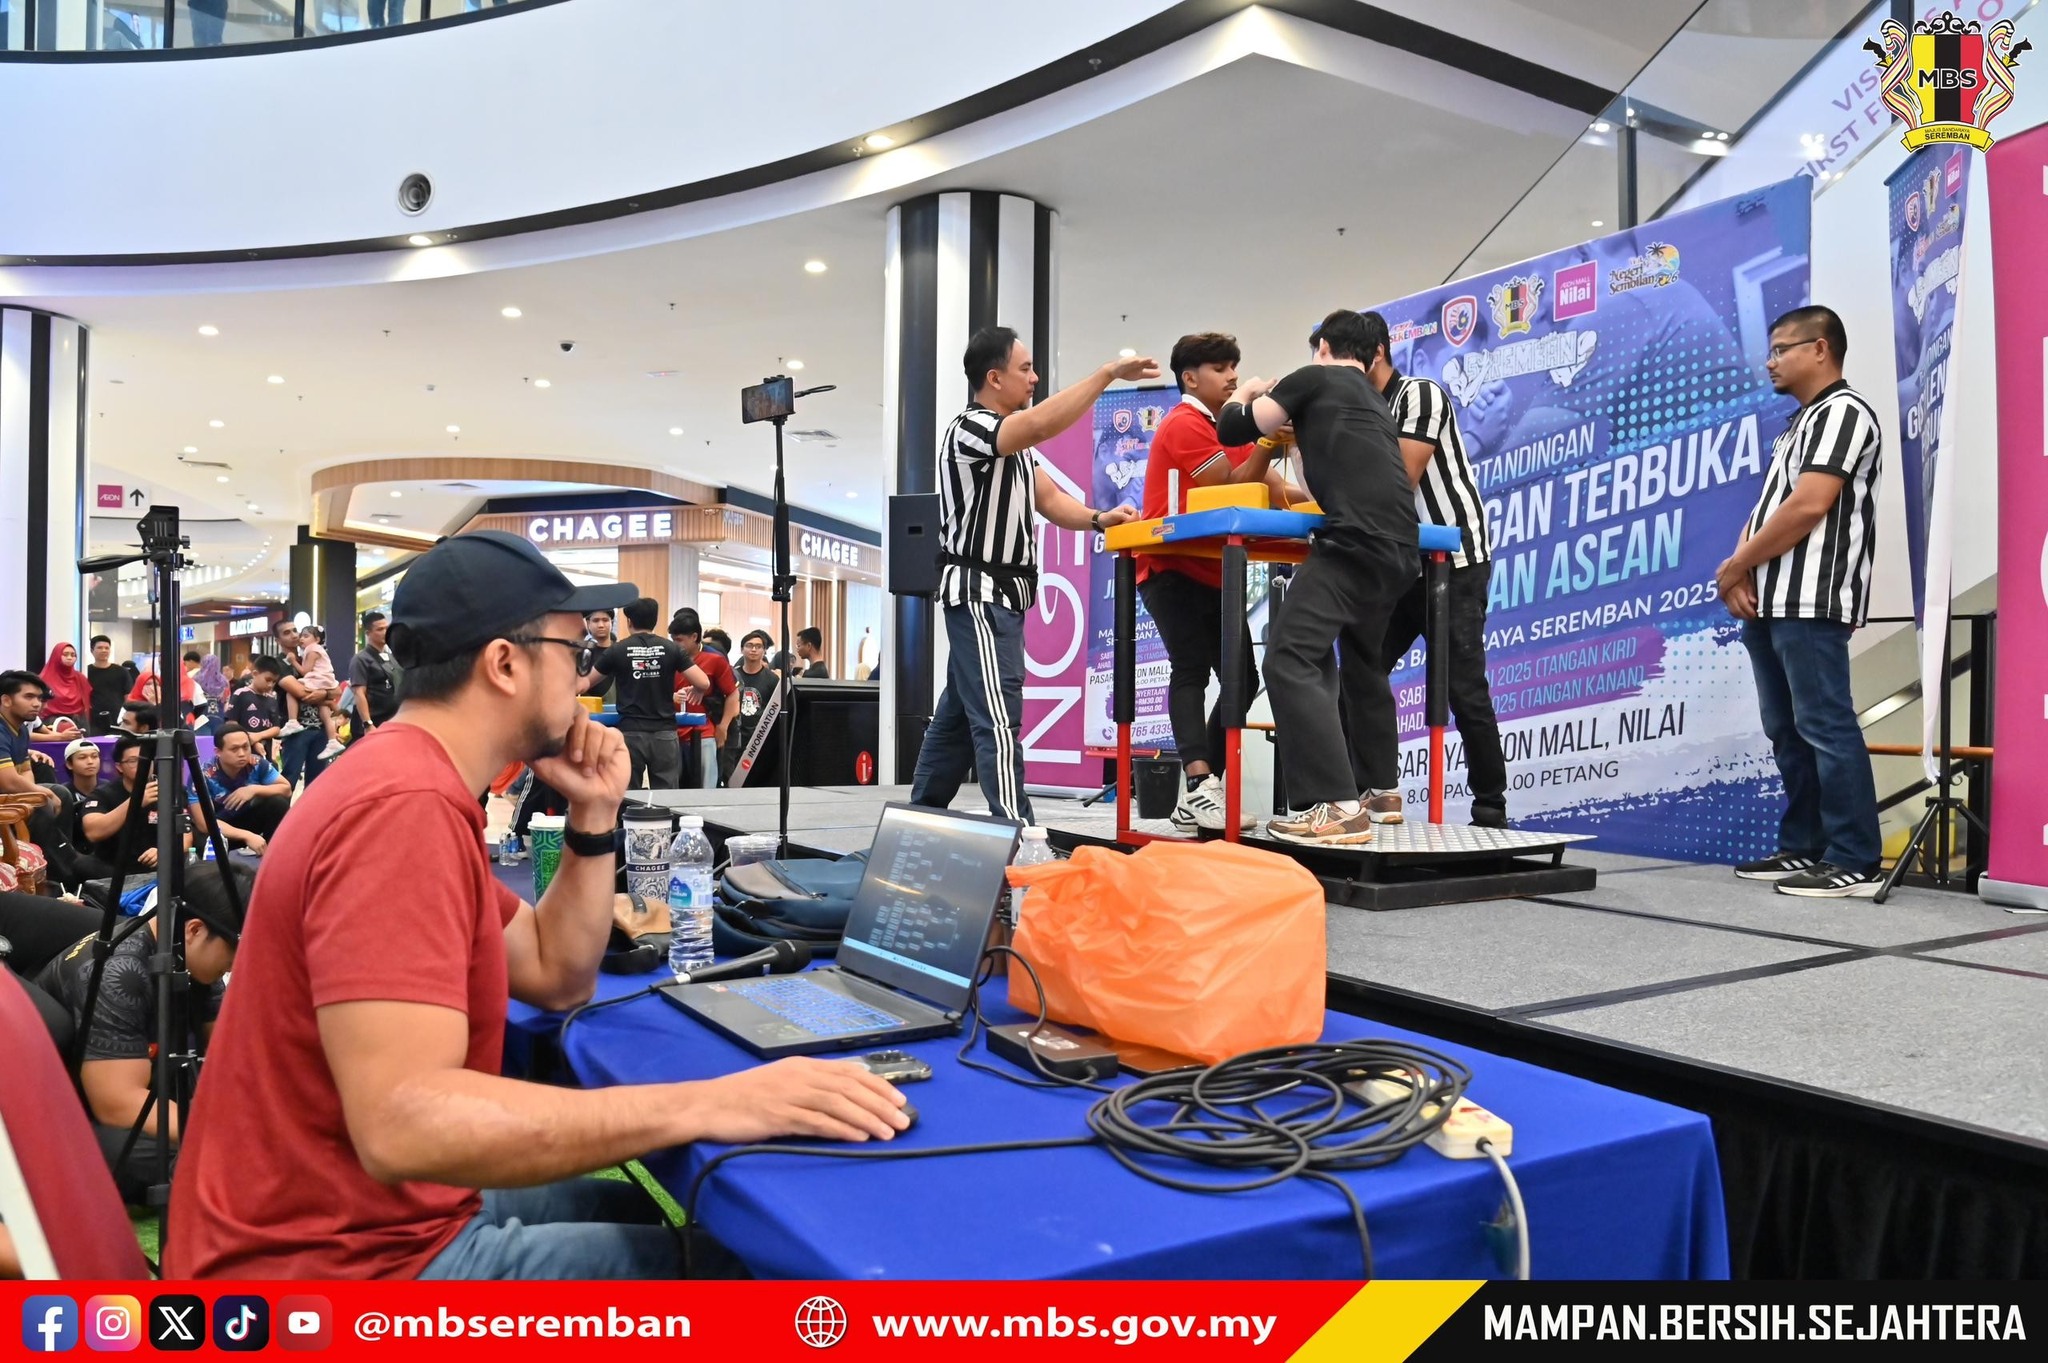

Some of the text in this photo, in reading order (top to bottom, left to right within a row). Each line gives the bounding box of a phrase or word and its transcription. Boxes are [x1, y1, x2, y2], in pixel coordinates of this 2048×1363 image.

[1505, 299, 1525, 311] MBS
[1559, 282, 1591, 306] Nilai
[1564, 413, 1761, 529] TERBUKA
[528, 512, 673, 543] CHAGEE
[800, 532, 859, 568] CHAGEE
[1545, 507, 1683, 599] ASEAN
[1529, 594, 1653, 641] SEREMBAN
[1659, 579, 1719, 613] 2025
[1149, 665, 1170, 676] MALL
[1497, 660, 1532, 687] 2025
[1536, 645, 1599, 678] (TANGAN
[1601, 636, 1638, 665] KIRI)
[1520, 679, 1582, 709] (TANGAN
[1584, 665, 1645, 696] KANAN)
[747, 701, 780, 759] INFORMATION
[1500, 728, 1533, 763] ON
[1539, 716, 1610, 758] MALL,
[1618, 701, 1686, 745] NILAI
[1540, 759, 1619, 787] PETANG
[635, 864, 666, 872] CHAGEE
